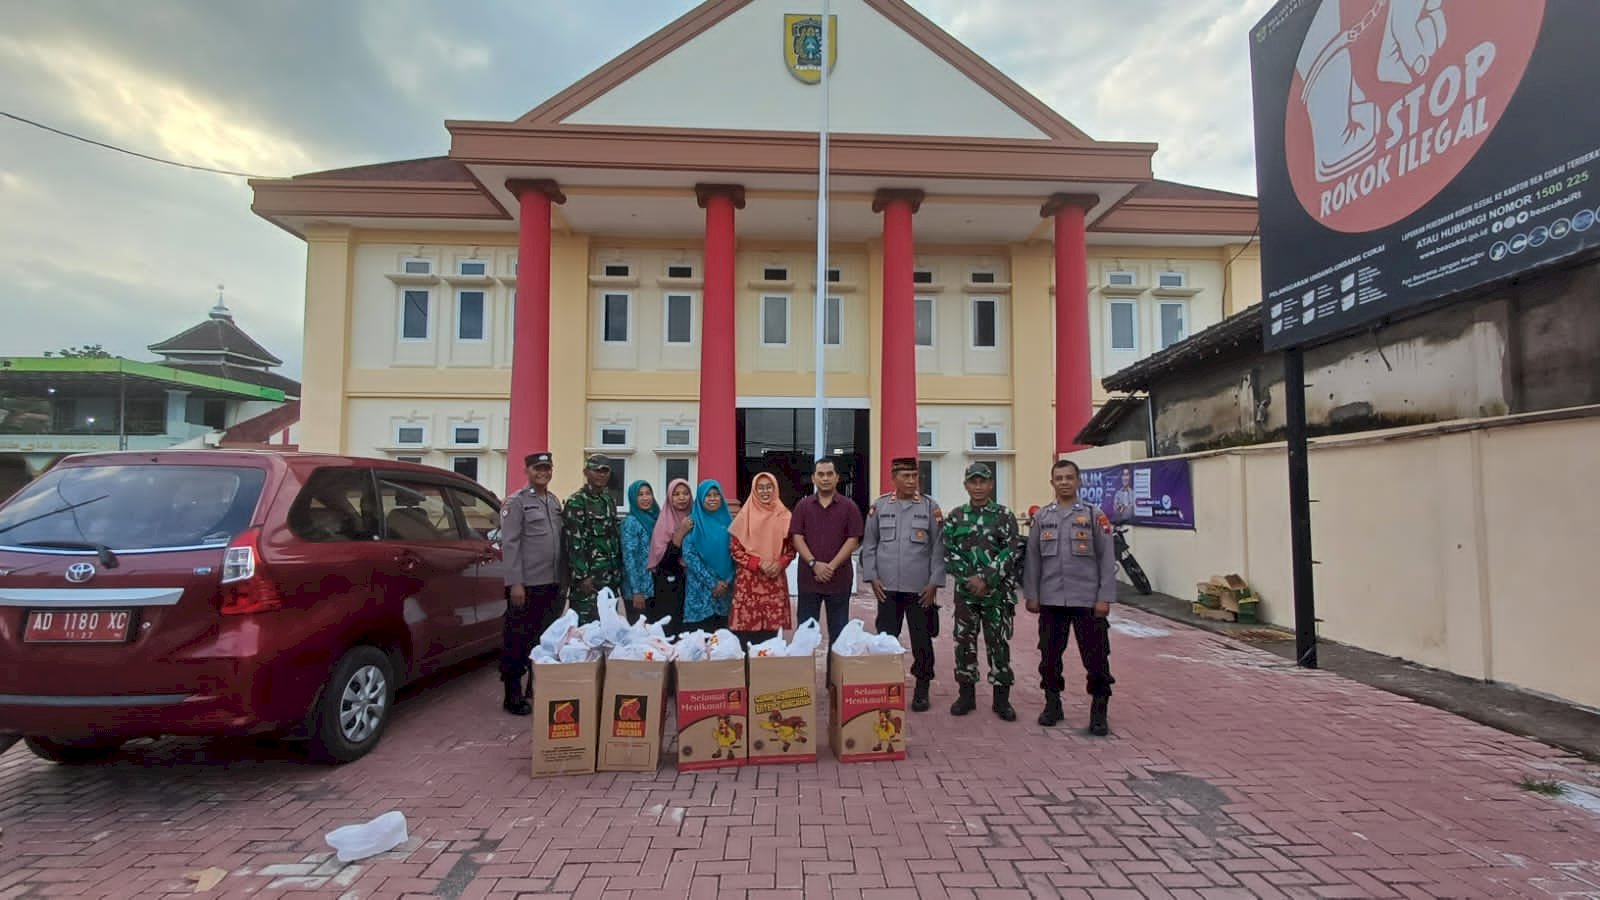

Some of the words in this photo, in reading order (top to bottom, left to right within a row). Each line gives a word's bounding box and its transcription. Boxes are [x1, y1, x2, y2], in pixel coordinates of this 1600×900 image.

[1385, 41, 1496, 150] STOP
[1319, 154, 1392, 219] ROKOK
[1398, 97, 1489, 177] ILEGAL
[1543, 164, 1566, 179] CUKAI
[1416, 232, 1439, 249] ATAU
[1440, 213, 1487, 240] HUBUNGI
[1488, 194, 1533, 219] NOMOR
[1535, 181, 1564, 200] 1500
[1566, 170, 1590, 188] 225
[33, 612, 54, 631] AD
[64, 612, 99, 631] 1180
[107, 611, 128, 630] XC
[689, 692, 725, 702] Selamat
